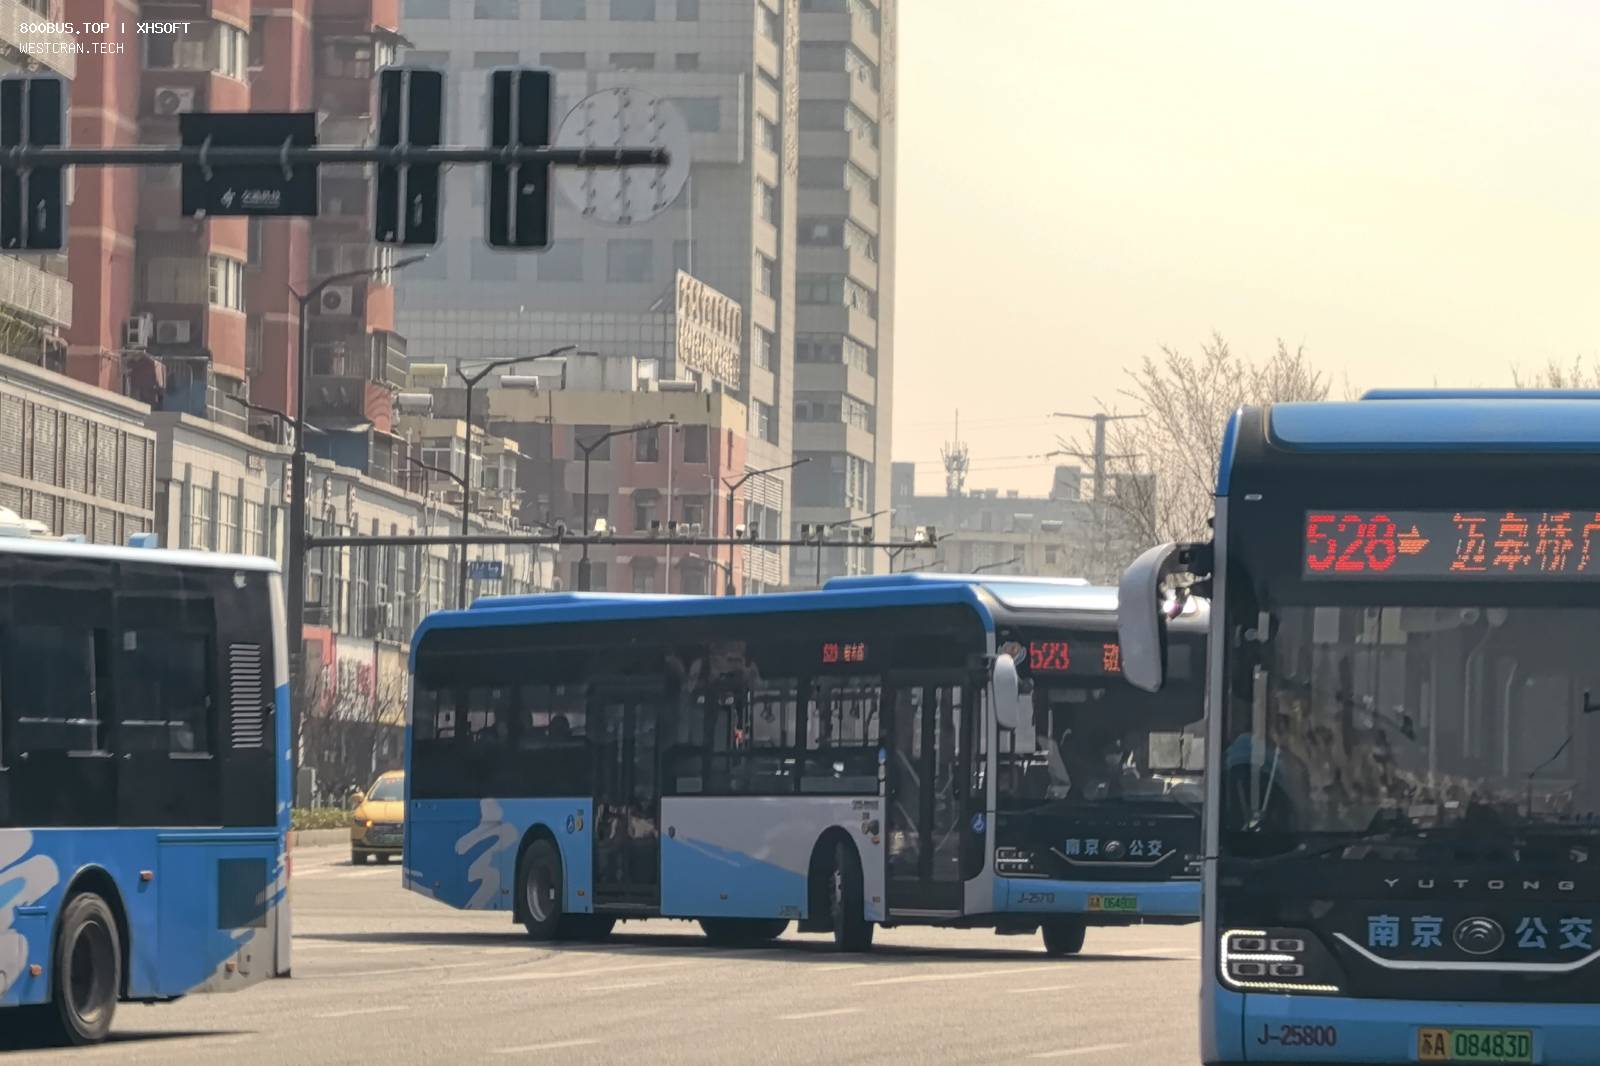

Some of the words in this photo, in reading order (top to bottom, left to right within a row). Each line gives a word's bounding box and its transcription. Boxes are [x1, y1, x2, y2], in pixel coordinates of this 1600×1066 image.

[1307, 514, 1397, 571] 528
[1029, 641, 1070, 672] 523
[1066, 838, 1099, 856] 南京
[1129, 839, 1162, 857] 公交
[1384, 878, 1575, 890] YUTONG
[1367, 914, 1443, 948] 南京
[1515, 917, 1593, 950] 公交
[1257, 1023, 1337, 1047] J-25800
[1455, 1033, 1529, 1058] 08483D
